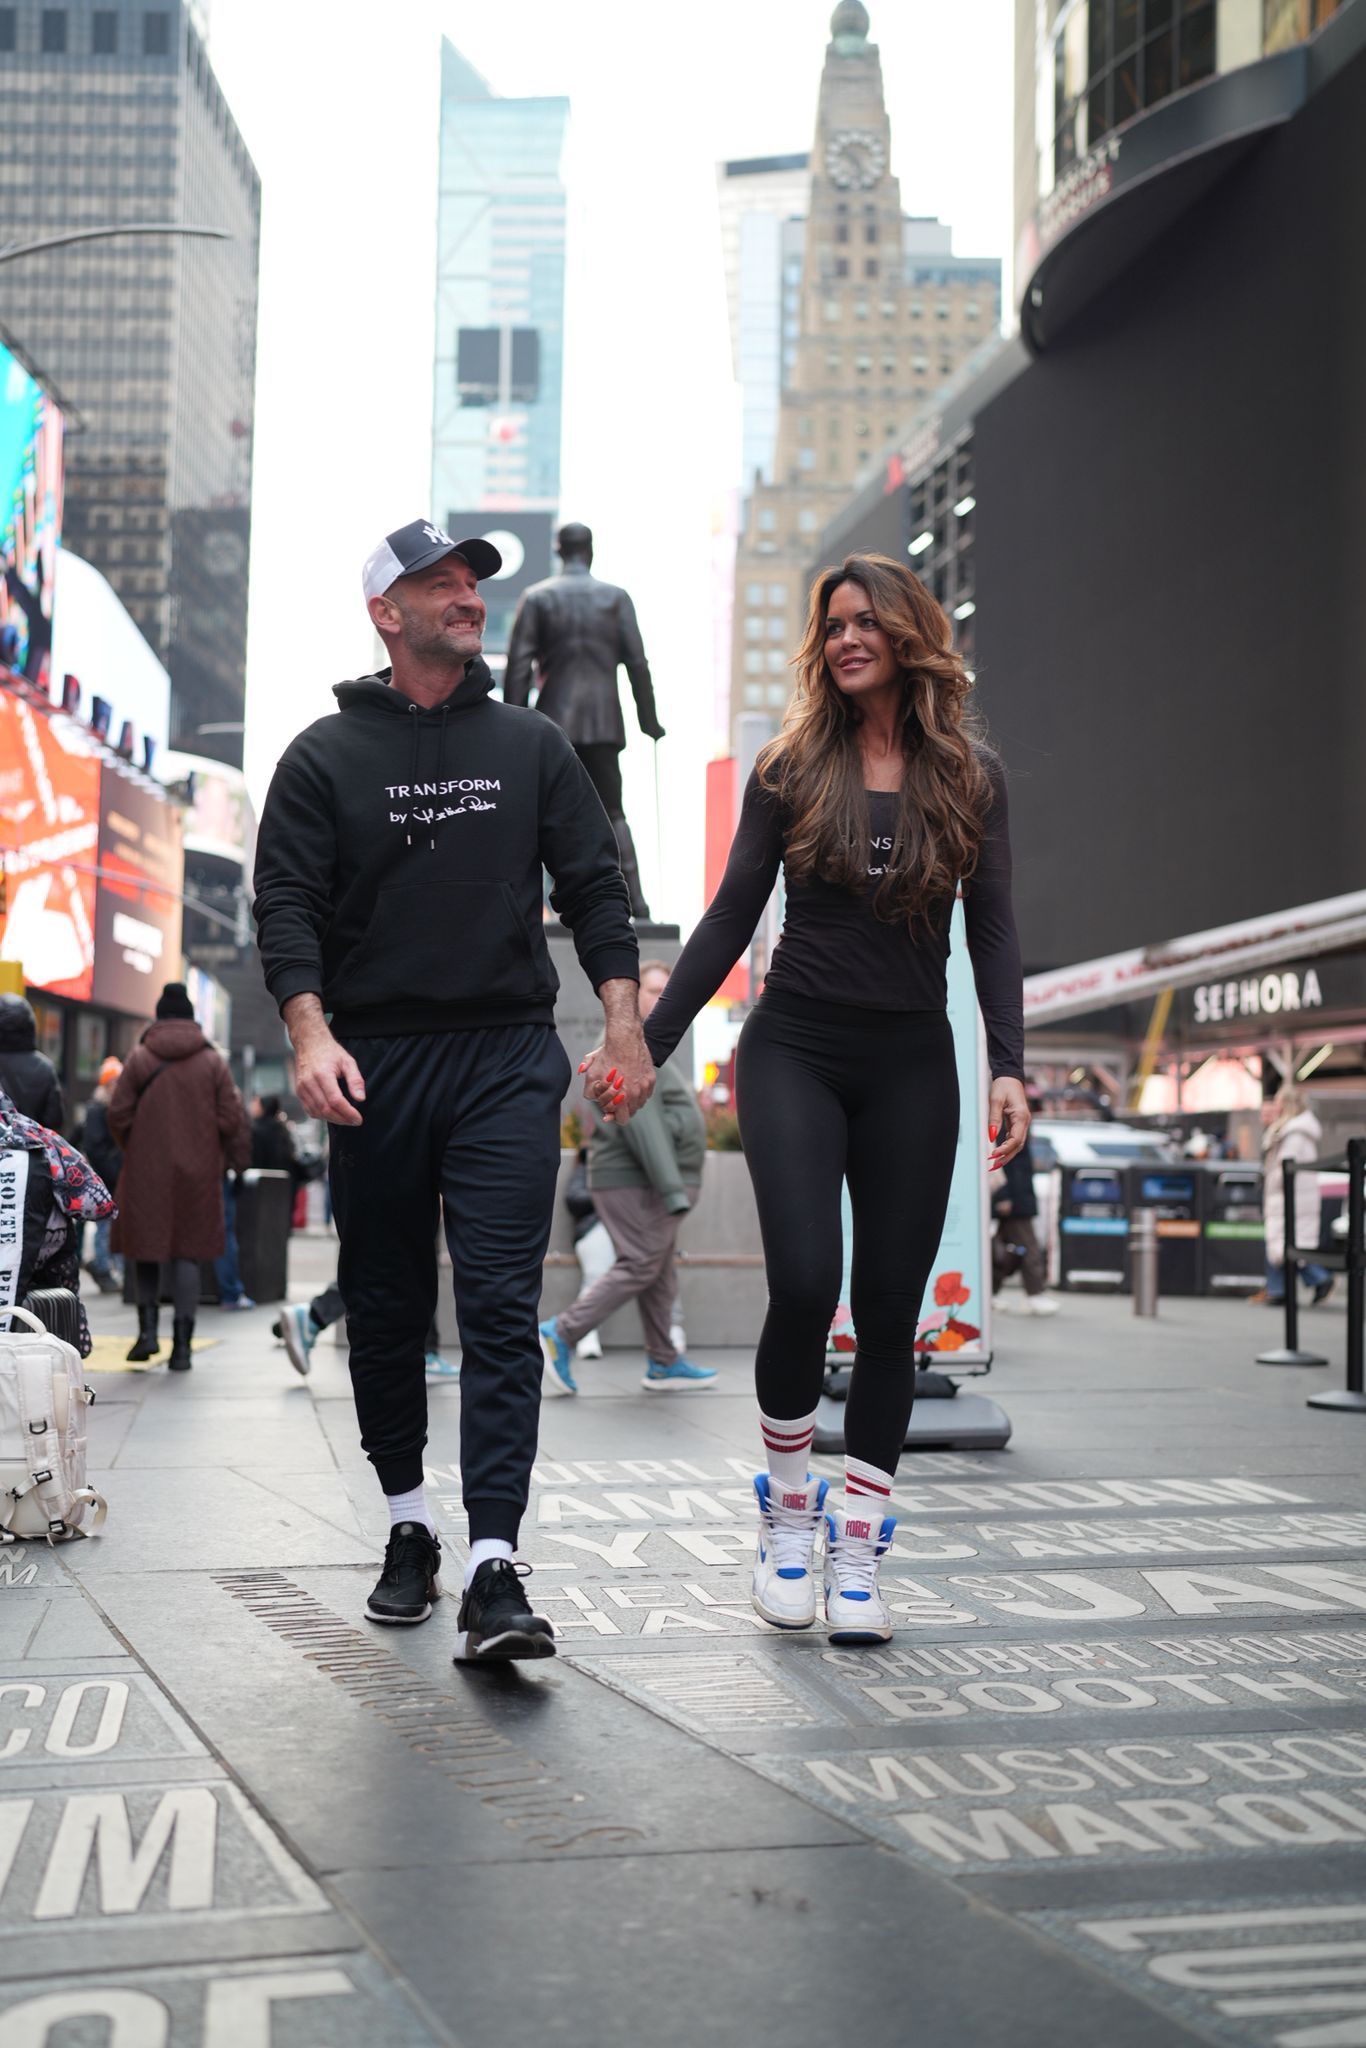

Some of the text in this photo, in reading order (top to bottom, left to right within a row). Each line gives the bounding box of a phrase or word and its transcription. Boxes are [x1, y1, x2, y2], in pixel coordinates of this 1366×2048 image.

[385, 779, 501, 799] TRANSFORM
[389, 811, 408, 824] by
[1194, 968, 1322, 1023] SEPHORA
[782, 1494, 808, 1510] FORCE
[845, 1520, 871, 1540] FORCE
[821, 1642, 1151, 1680] SHUBERT
[860, 1670, 1352, 1719] BOOTH
[803, 1744, 1212, 1804] MUSIC
